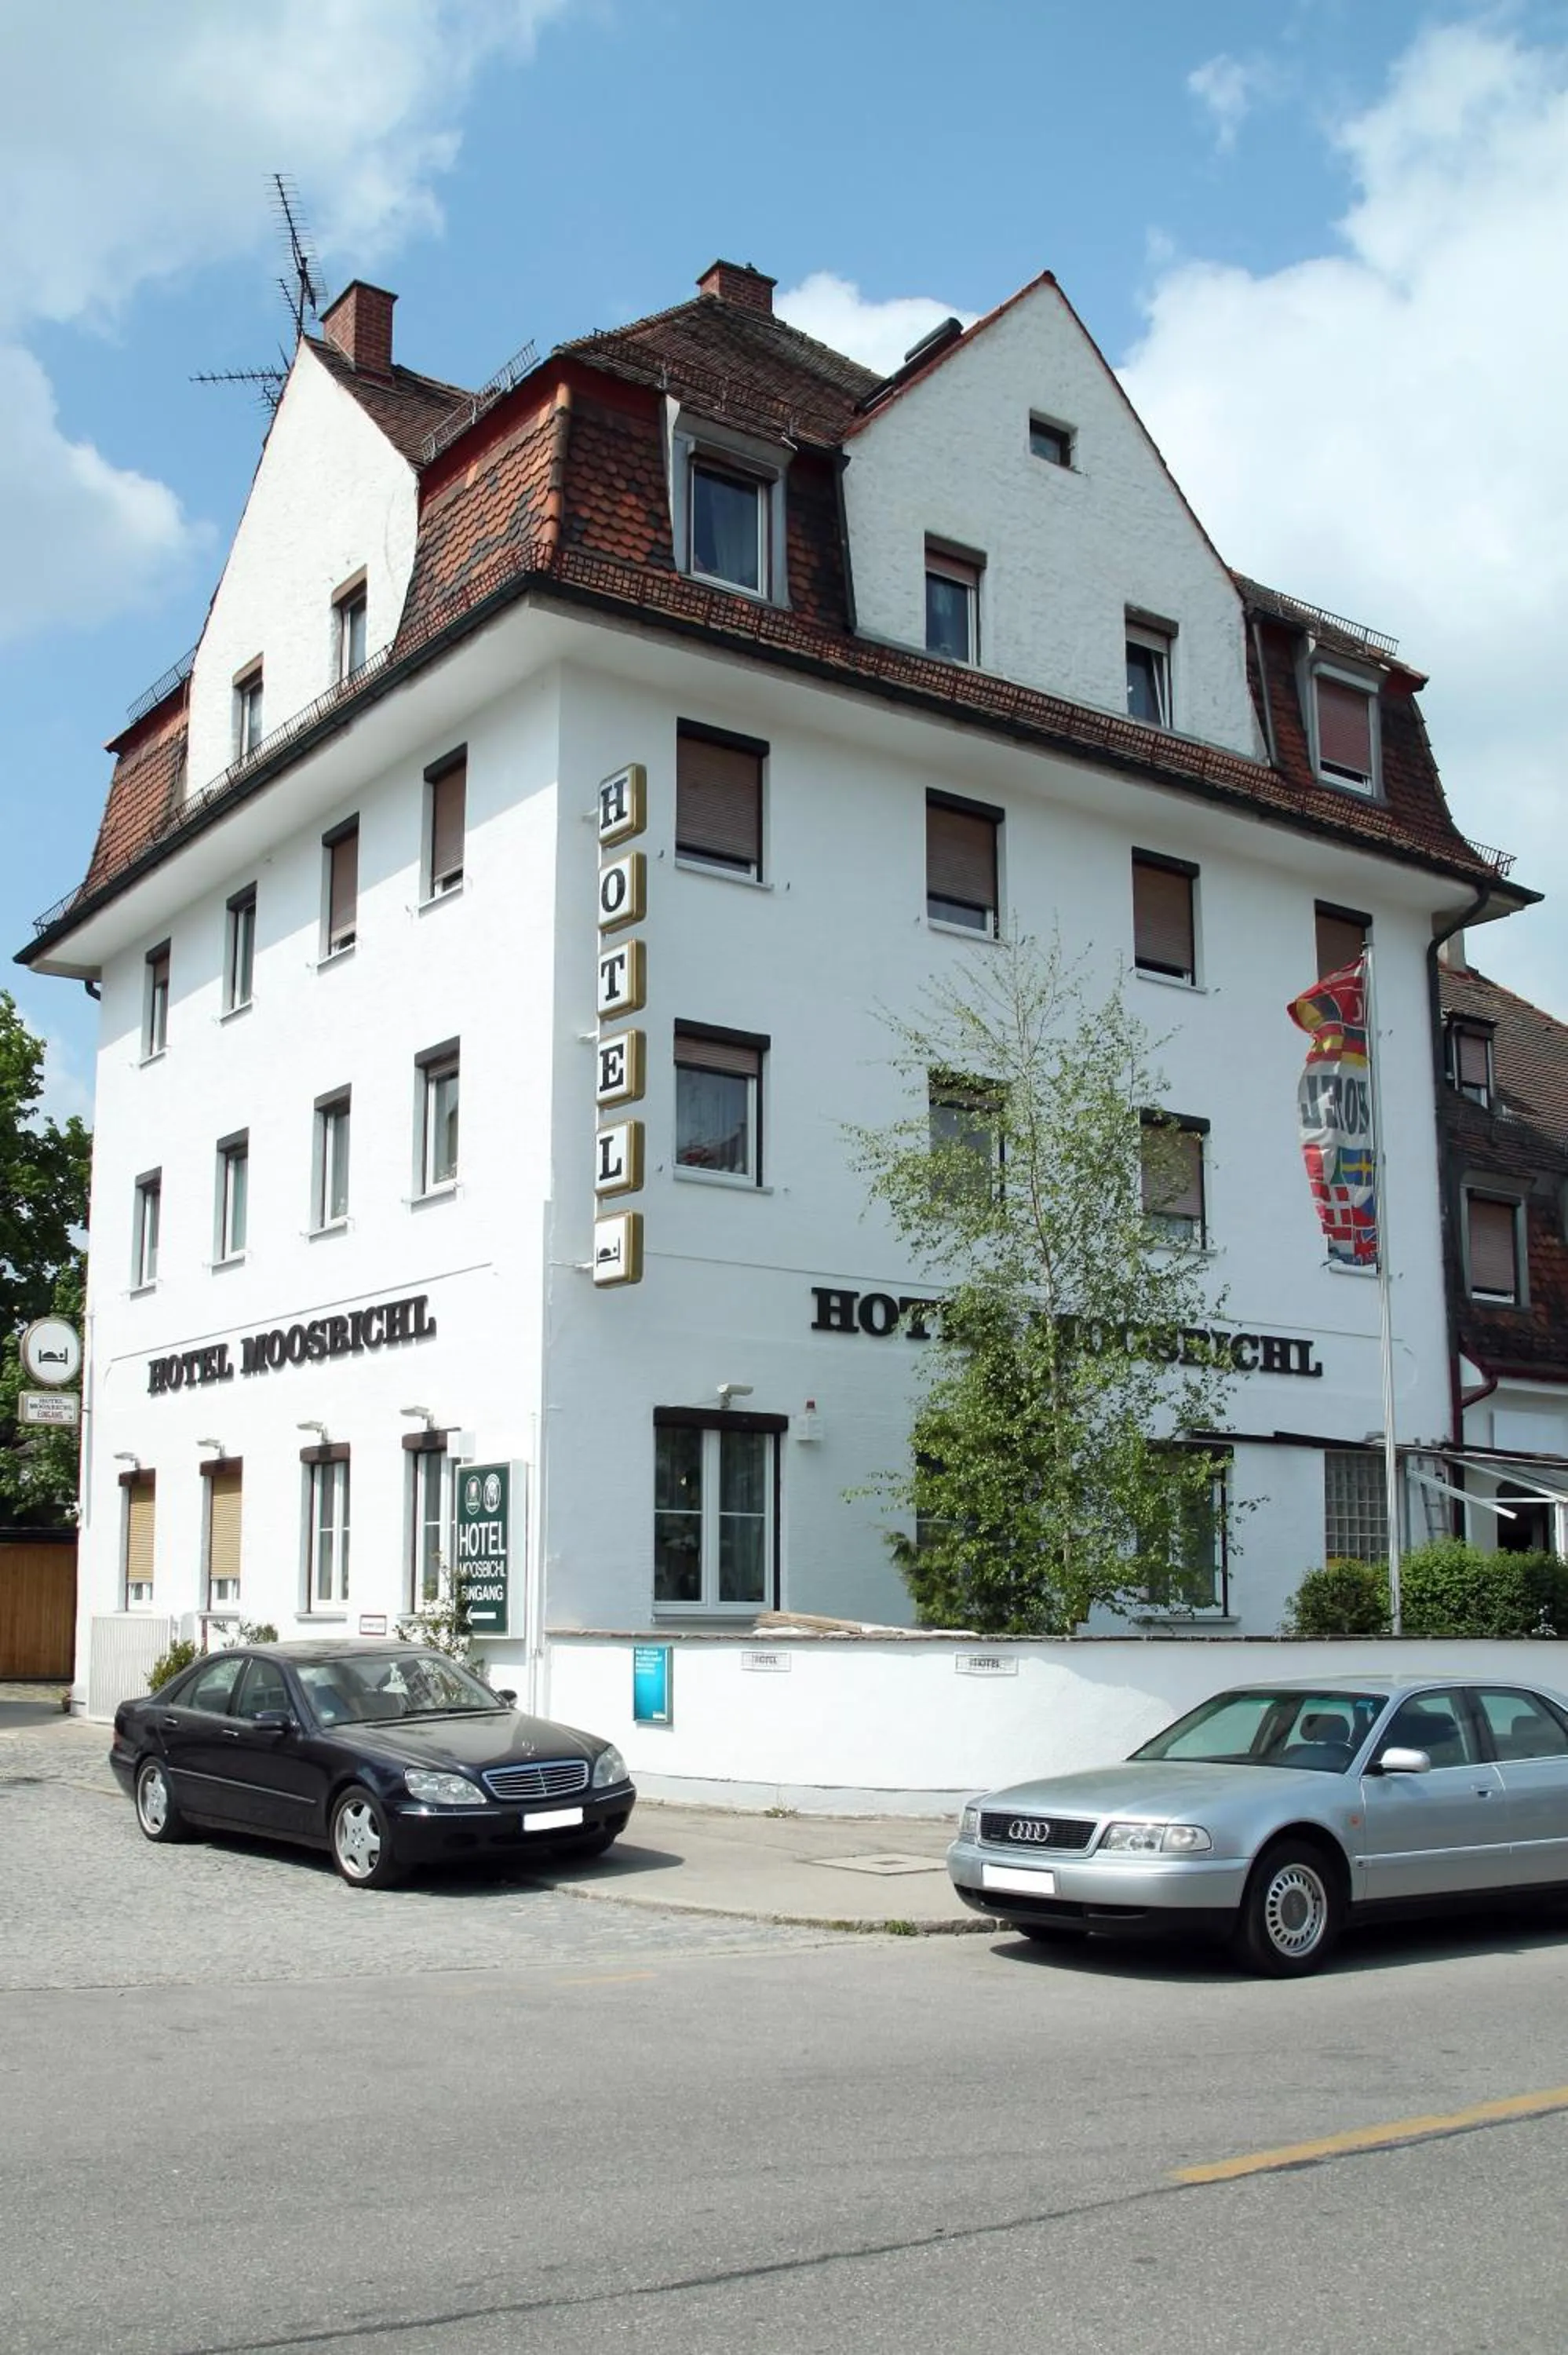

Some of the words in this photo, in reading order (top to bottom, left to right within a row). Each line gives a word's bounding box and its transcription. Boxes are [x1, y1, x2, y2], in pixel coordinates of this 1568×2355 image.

[598, 776, 629, 1181] HOTEL
[811, 1287, 977, 1342] HOT
[147, 1343, 235, 1395] HOTEL
[240, 1294, 436, 1375] MOOSBICHL
[459, 1521, 506, 1557] HOTEL
[459, 1560, 506, 1578] MOOSBICHL
